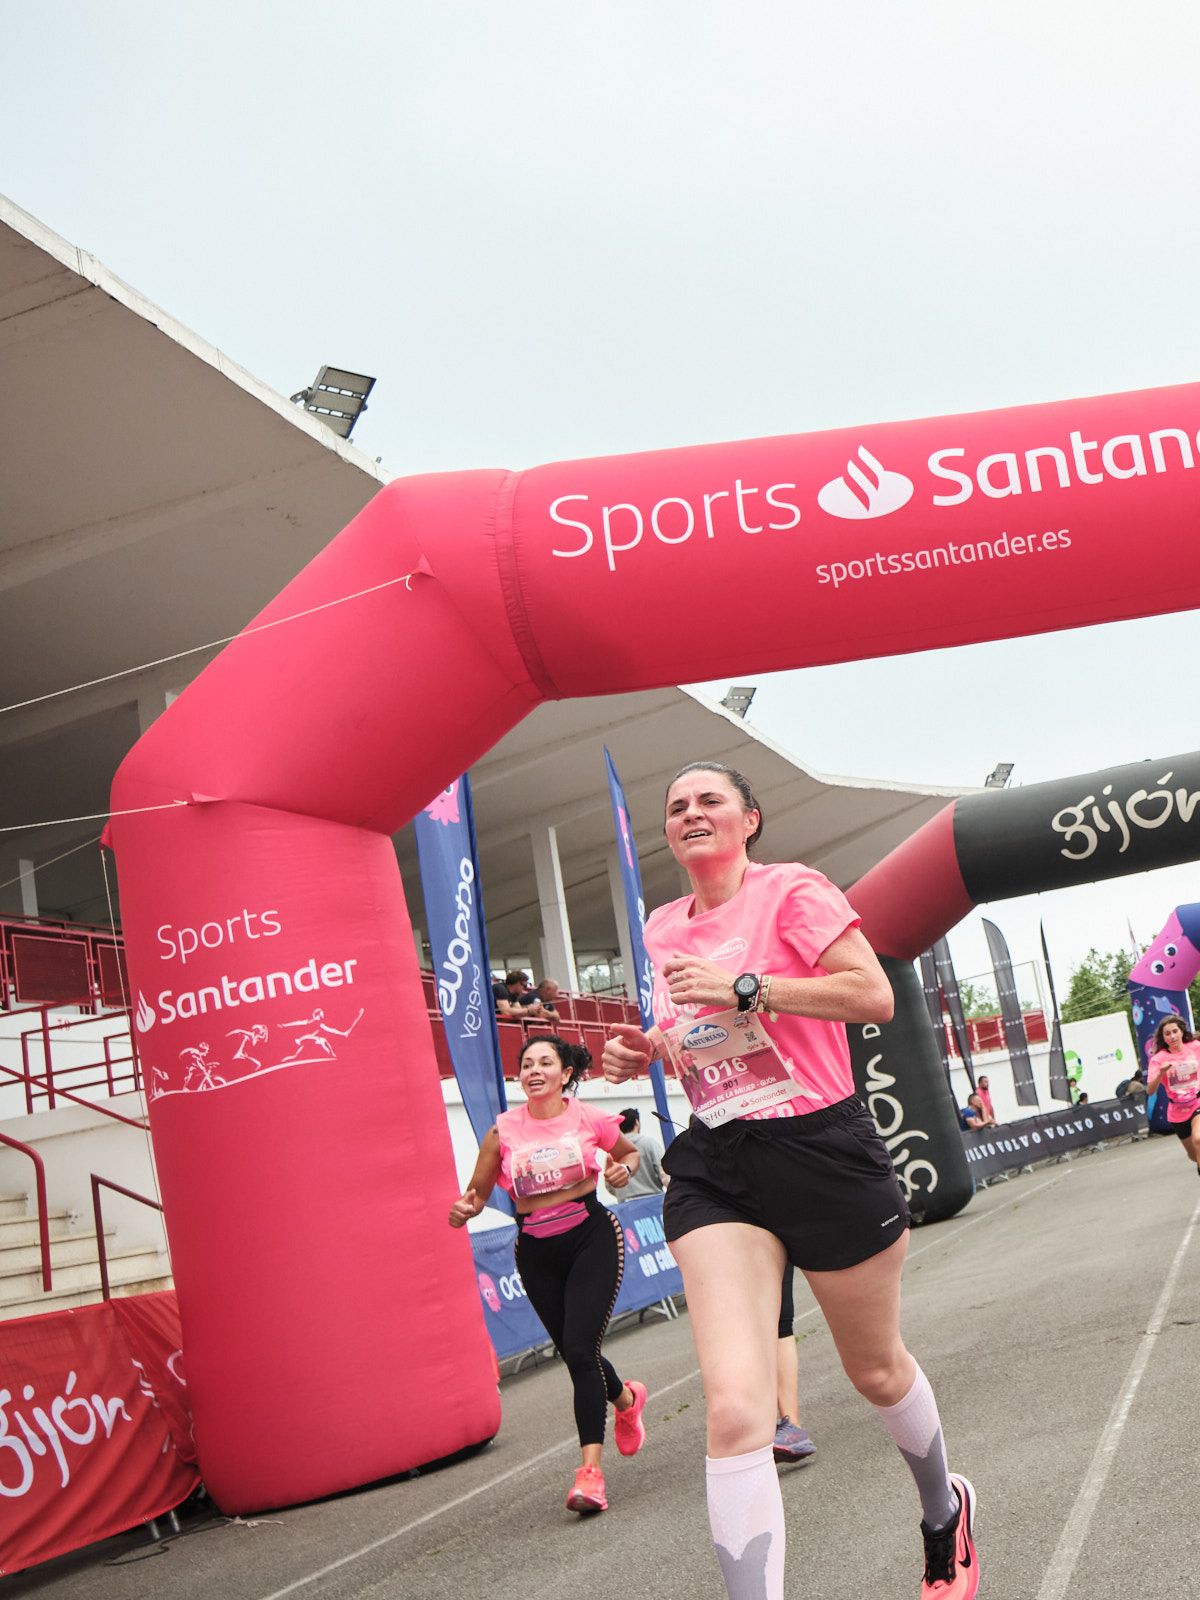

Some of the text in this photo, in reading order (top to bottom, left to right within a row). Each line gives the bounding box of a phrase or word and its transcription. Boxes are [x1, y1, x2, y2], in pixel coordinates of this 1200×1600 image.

[548, 478, 802, 572] Sports
[815, 529, 1072, 589] sportssantander.es
[157, 908, 282, 963] Sports
[158, 958, 358, 1025] Santander
[687, 1031, 727, 1047] ASTURIANA
[703, 1057, 748, 1085] 016
[722, 1078, 739, 1091] 901
[725, 1091, 734, 1099] LA
[750, 1087, 787, 1105] Santander
[996, 1131, 1041, 1154] VOLVO
[1044, 1117, 1094, 1140] VOLVO
[1100, 1104, 1146, 1125] VOLV
[535, 1168, 563, 1184] 016
